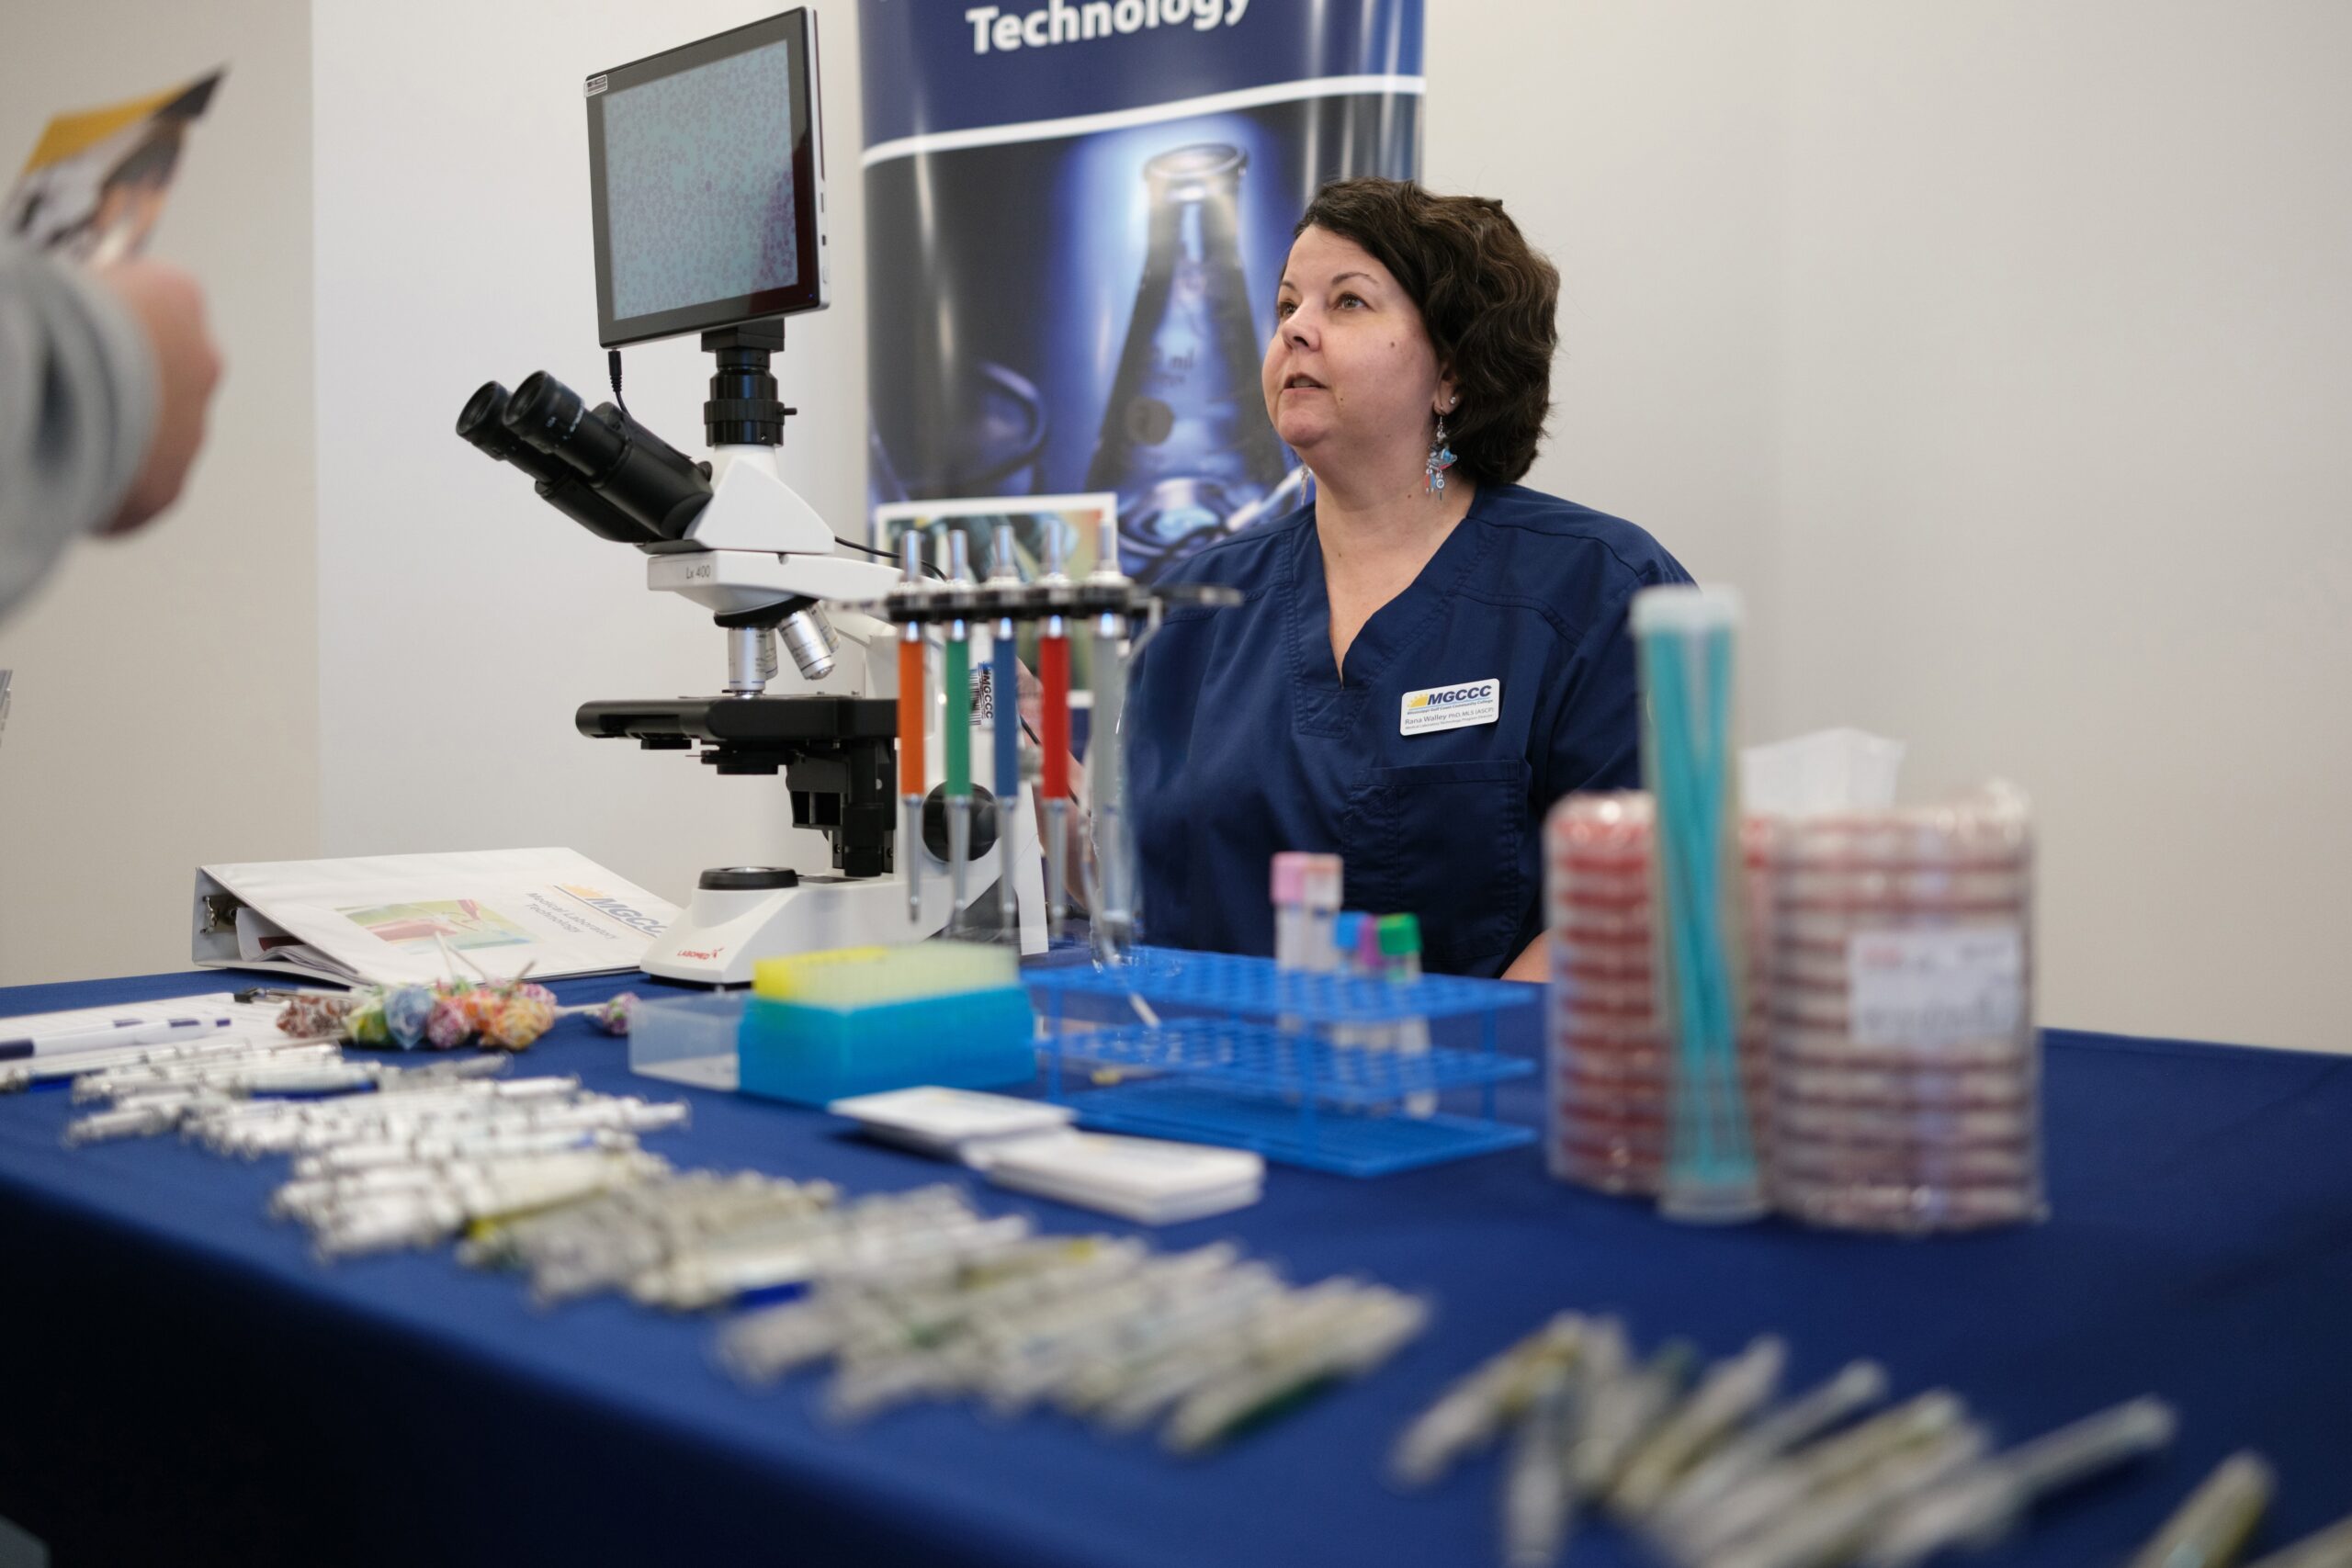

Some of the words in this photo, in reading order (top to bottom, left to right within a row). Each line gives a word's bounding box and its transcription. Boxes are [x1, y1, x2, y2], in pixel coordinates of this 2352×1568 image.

[966, 0, 1250, 54] Technology
[695, 565, 711, 579] 400
[983, 676, 993, 718] MGCCC
[1427, 684, 1492, 705] MGCCC
[1405, 717, 1423, 726] Rana
[1423, 714, 1448, 723] Walley
[526, 892, 569, 913] Medical
[526, 903, 584, 933] Technology
